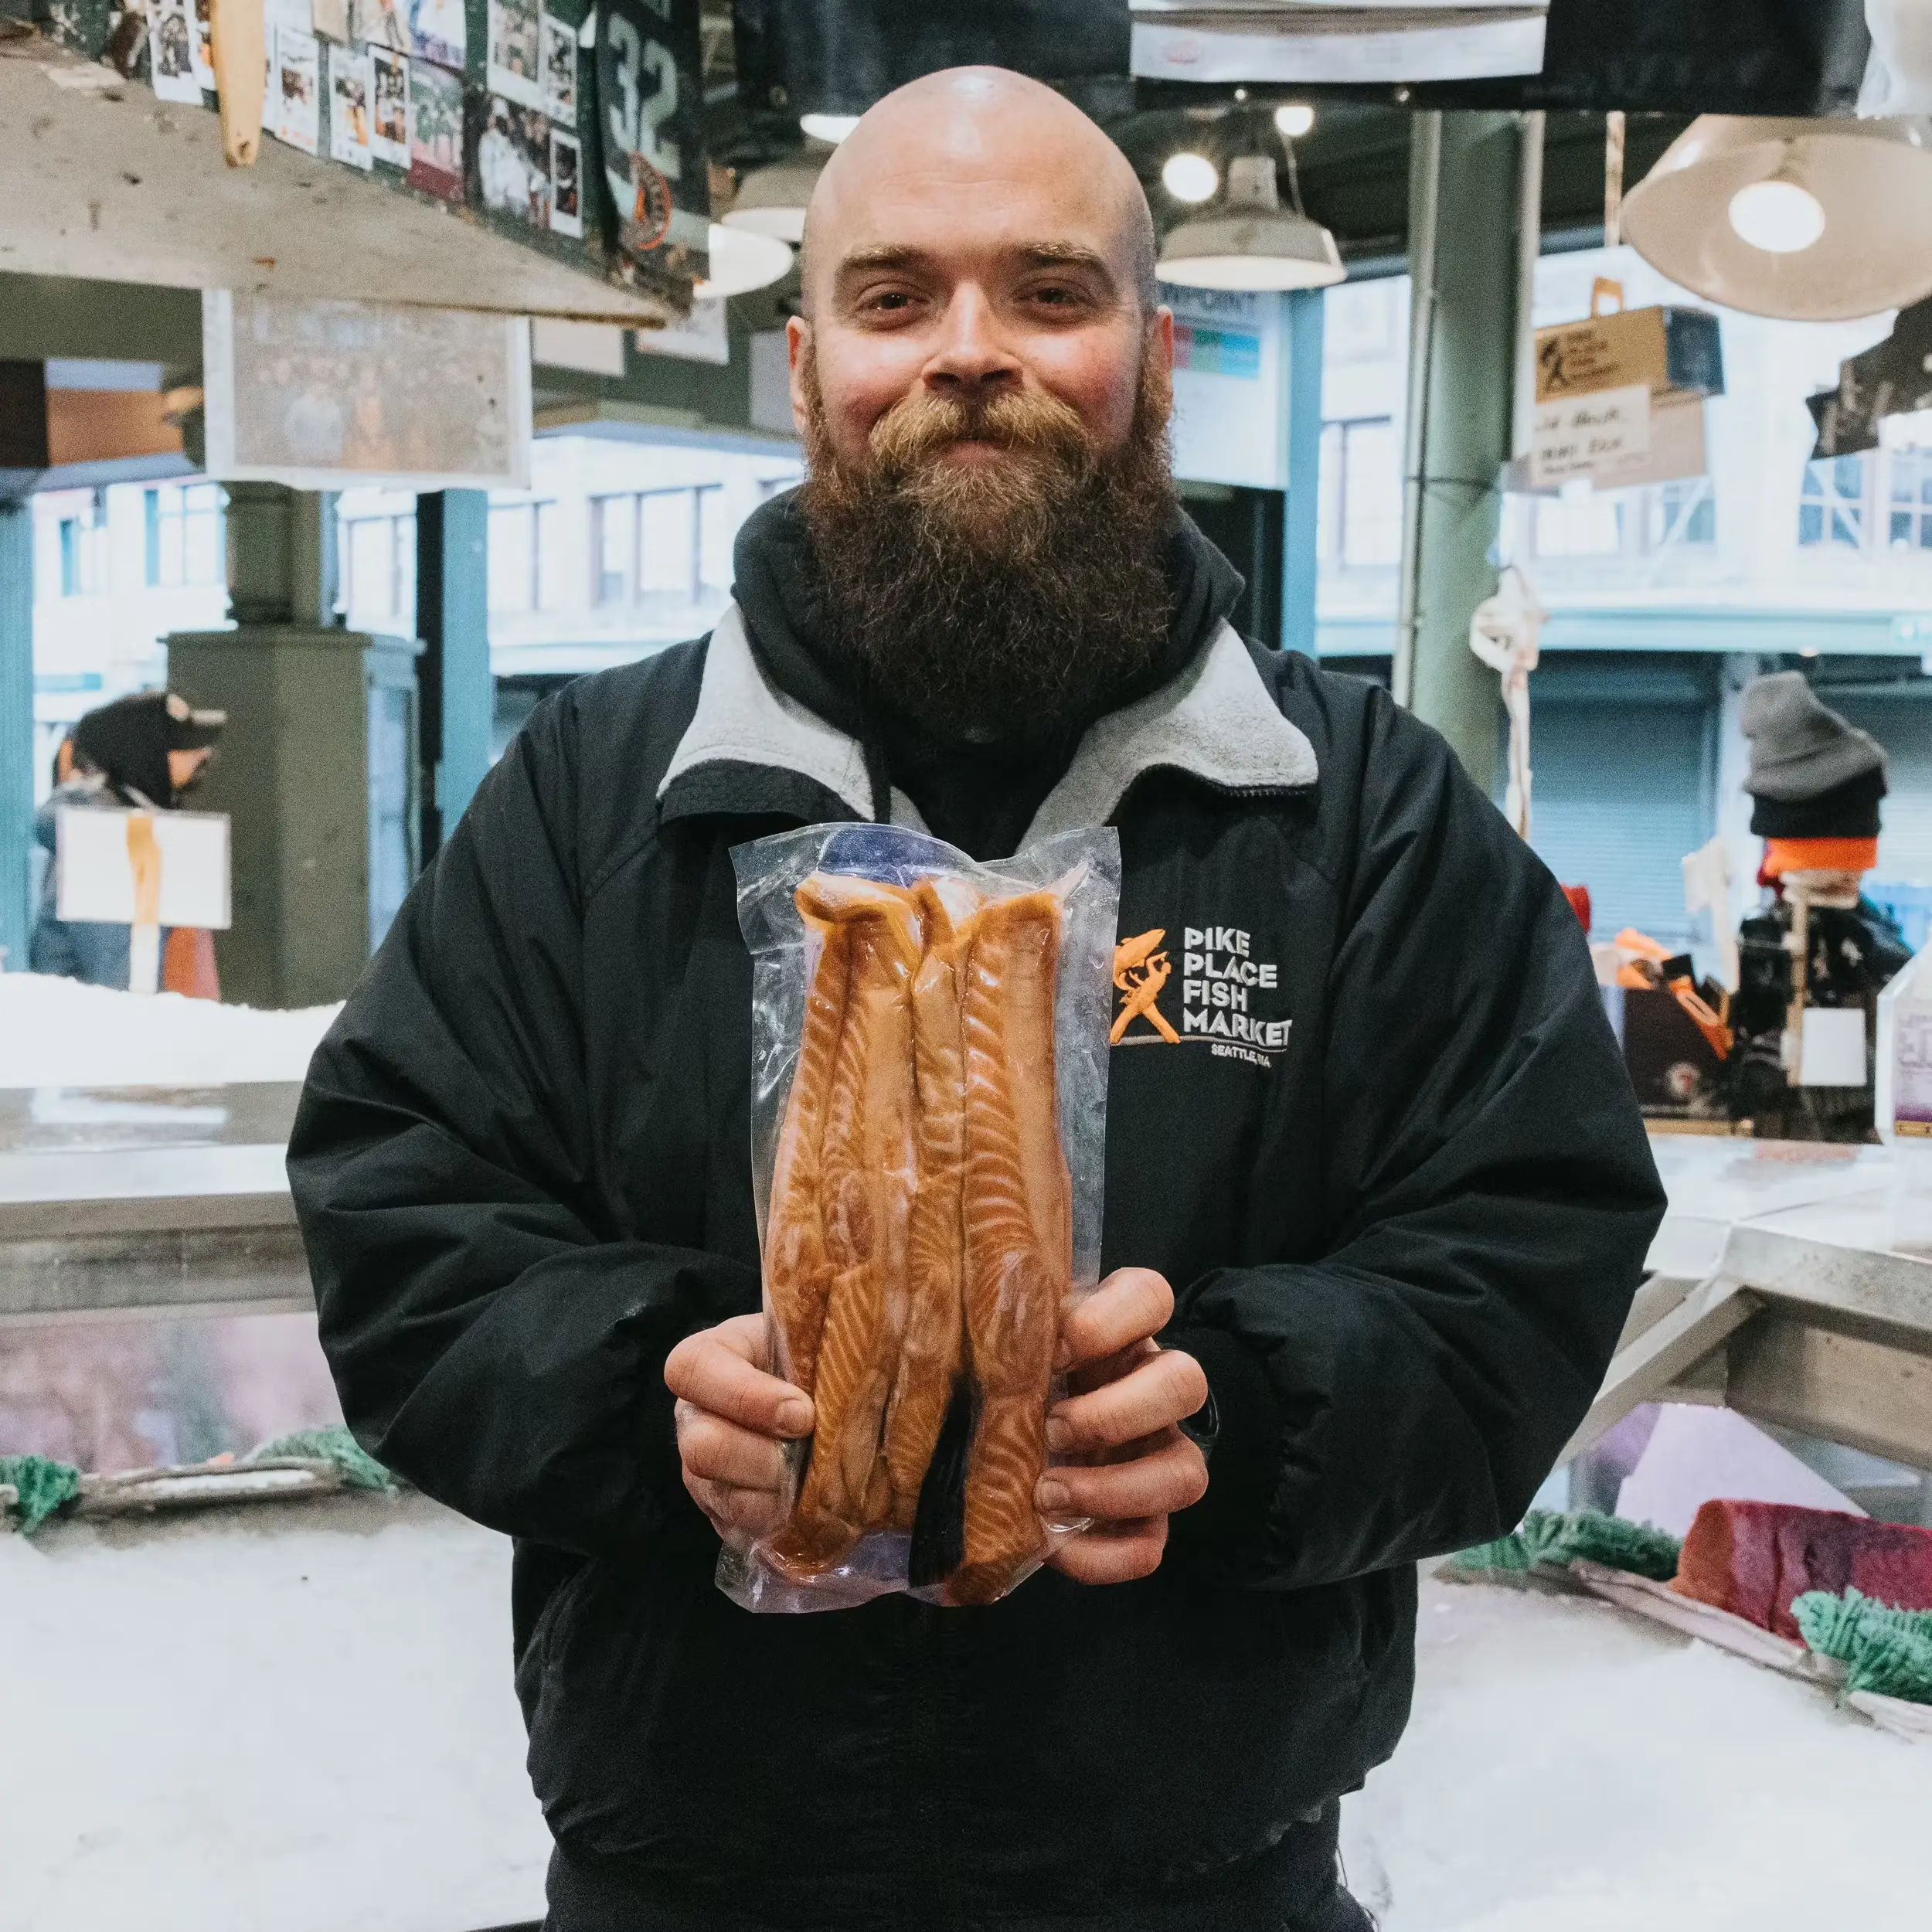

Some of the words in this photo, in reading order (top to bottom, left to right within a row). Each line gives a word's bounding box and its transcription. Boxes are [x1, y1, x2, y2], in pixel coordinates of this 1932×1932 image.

[608, 12, 681, 180] 32
[1184, 927, 1250, 957] PIKE
[1183, 952, 1278, 988] PLACE
[1183, 979, 1248, 1012] FISH
[1183, 1007, 1293, 1046] MARKET
